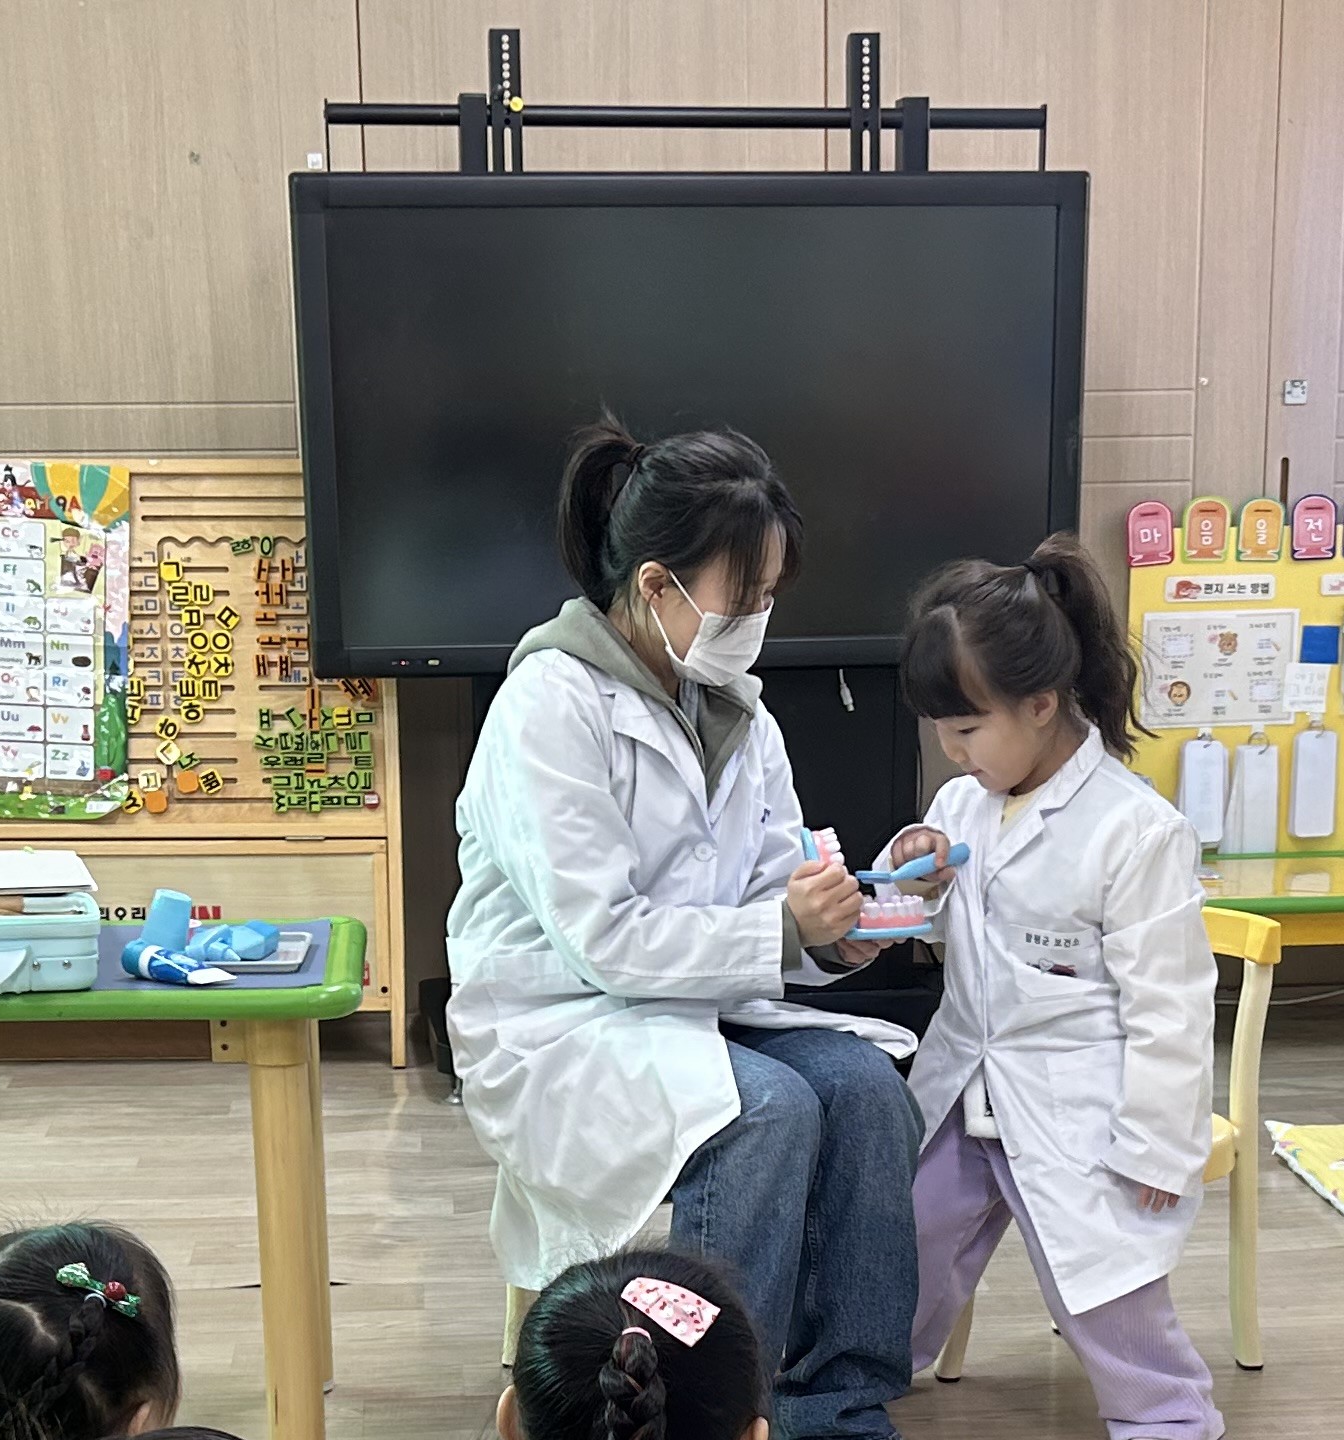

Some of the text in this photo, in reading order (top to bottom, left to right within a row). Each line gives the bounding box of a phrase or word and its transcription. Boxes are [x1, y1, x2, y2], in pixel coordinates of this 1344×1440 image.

[1, 526, 20, 539] Cc
[3, 563, 18, 576] Ff
[0, 637, 26, 649] Mm
[50, 639, 70, 651] Nn
[52, 676, 69, 687] Rr
[0, 710, 20, 723] Uu
[51, 713, 69, 725] Vv
[50, 749, 69, 762] Zz
